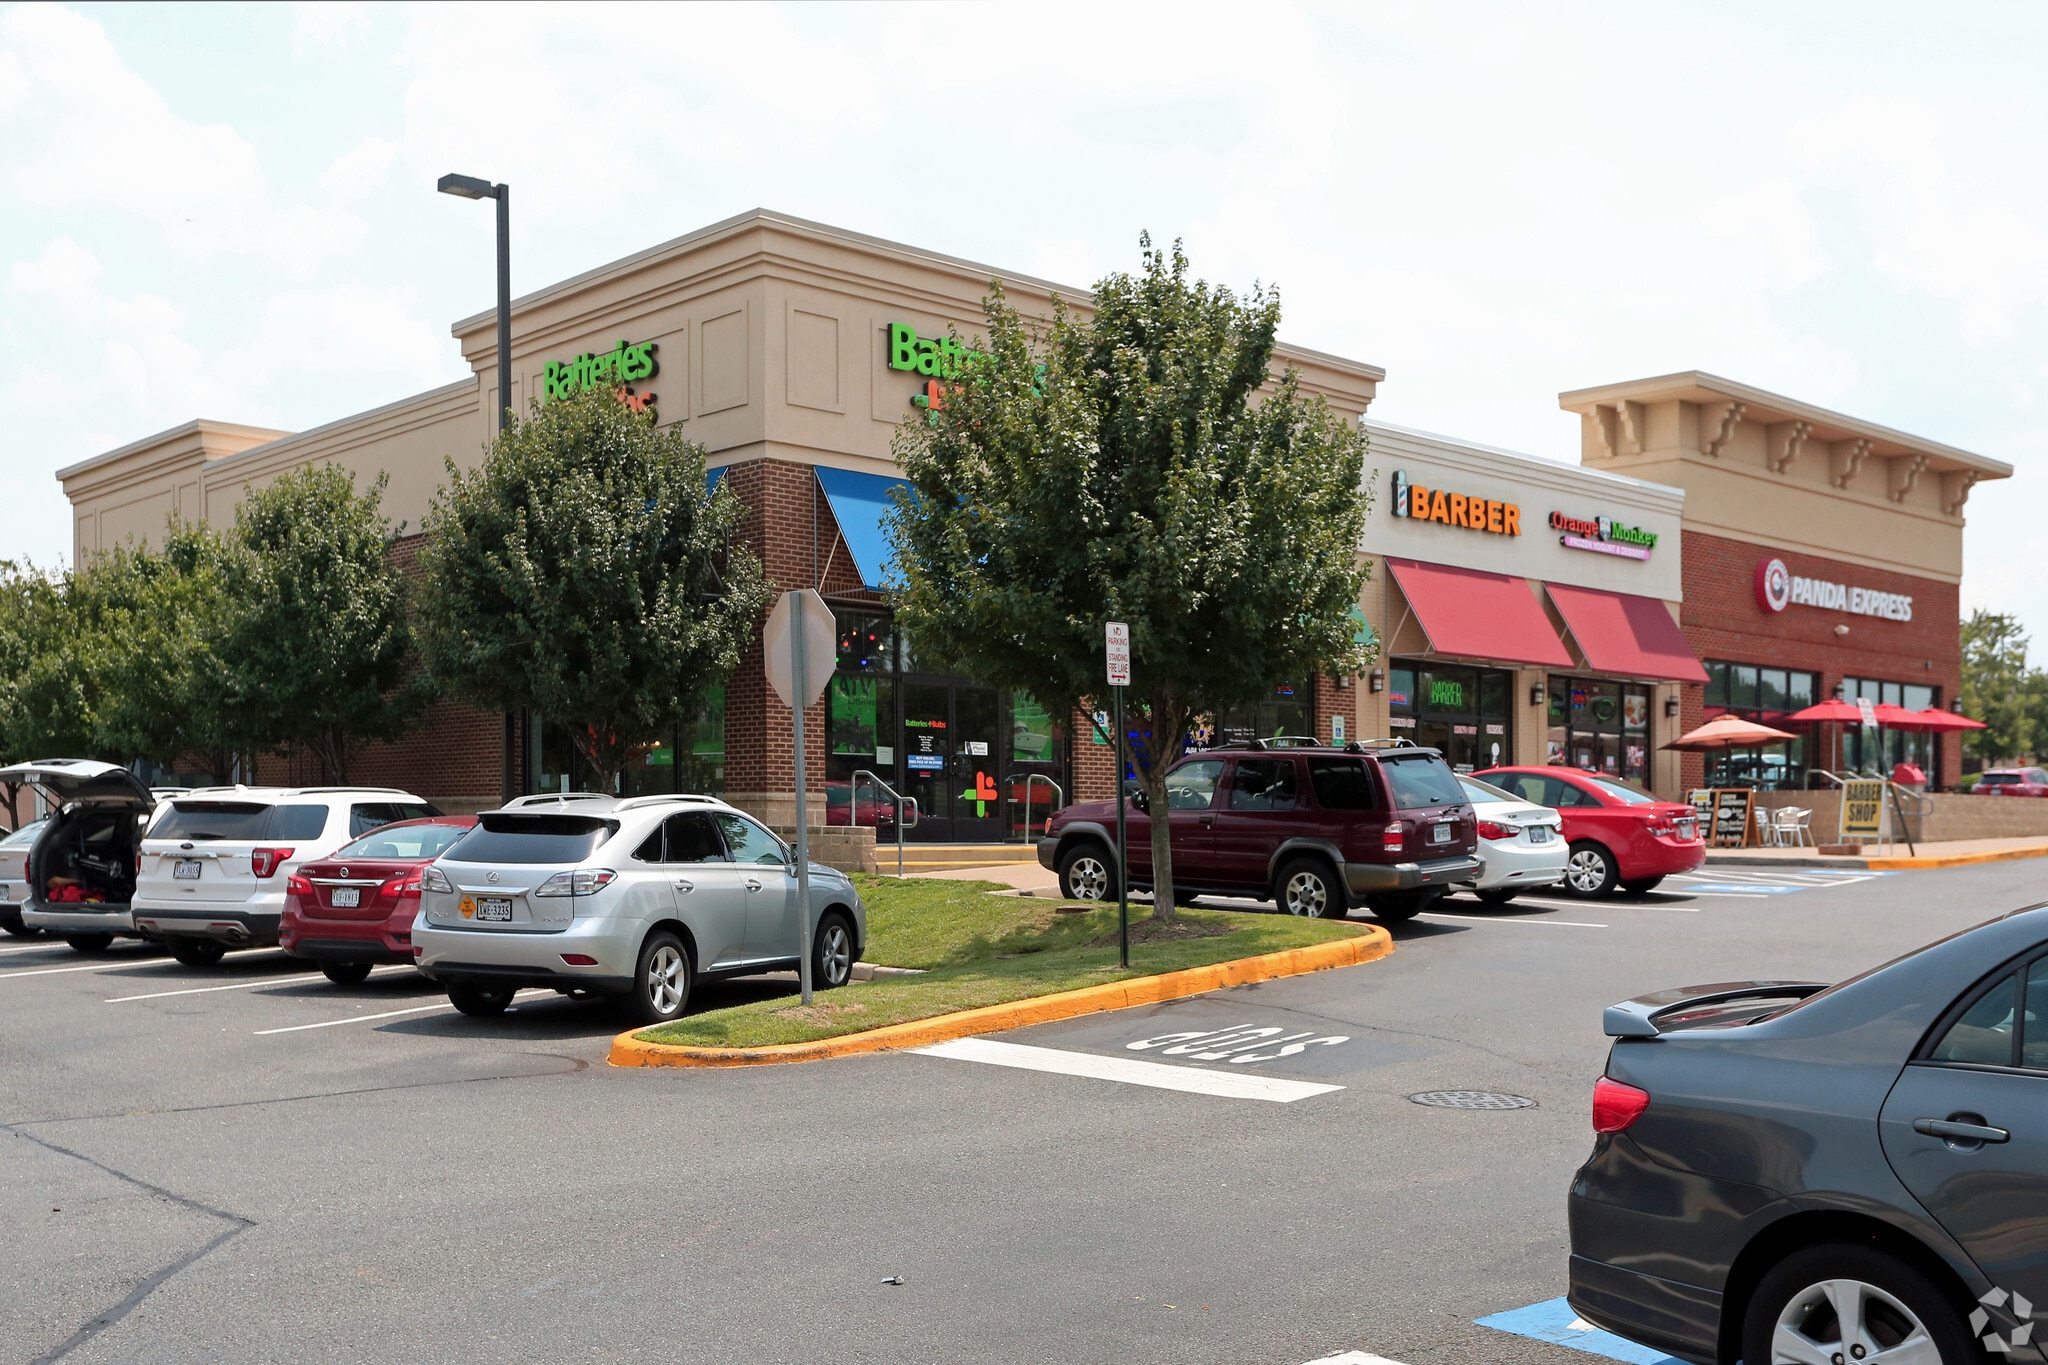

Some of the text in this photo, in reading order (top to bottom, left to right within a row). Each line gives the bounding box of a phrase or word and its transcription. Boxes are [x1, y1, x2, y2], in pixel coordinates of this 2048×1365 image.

[1409, 484, 1522, 537] BARBER
[1550, 510, 1659, 549] Orange Monkey
[1570, 537, 1592, 549] FROZEN
[1593, 542, 1615, 553] YOGURT
[1621, 547, 1645, 558] DESSERT
[1791, 576, 1913, 622] PANDA EXPRESS
[1113, 627, 1121, 636] NO
[1107, 637, 1127, 646] PARKING
[1108, 653, 1128, 662] STANDING
[1108, 663, 1128, 673] FIRE LANE
[1431, 681, 1463, 706] BARBER
[905, 719, 928, 728] Batteries
[1846, 783, 1882, 801] BARBER
[1848, 803, 1877, 822] SHOP
[1126, 1023, 1350, 1064] STOP
